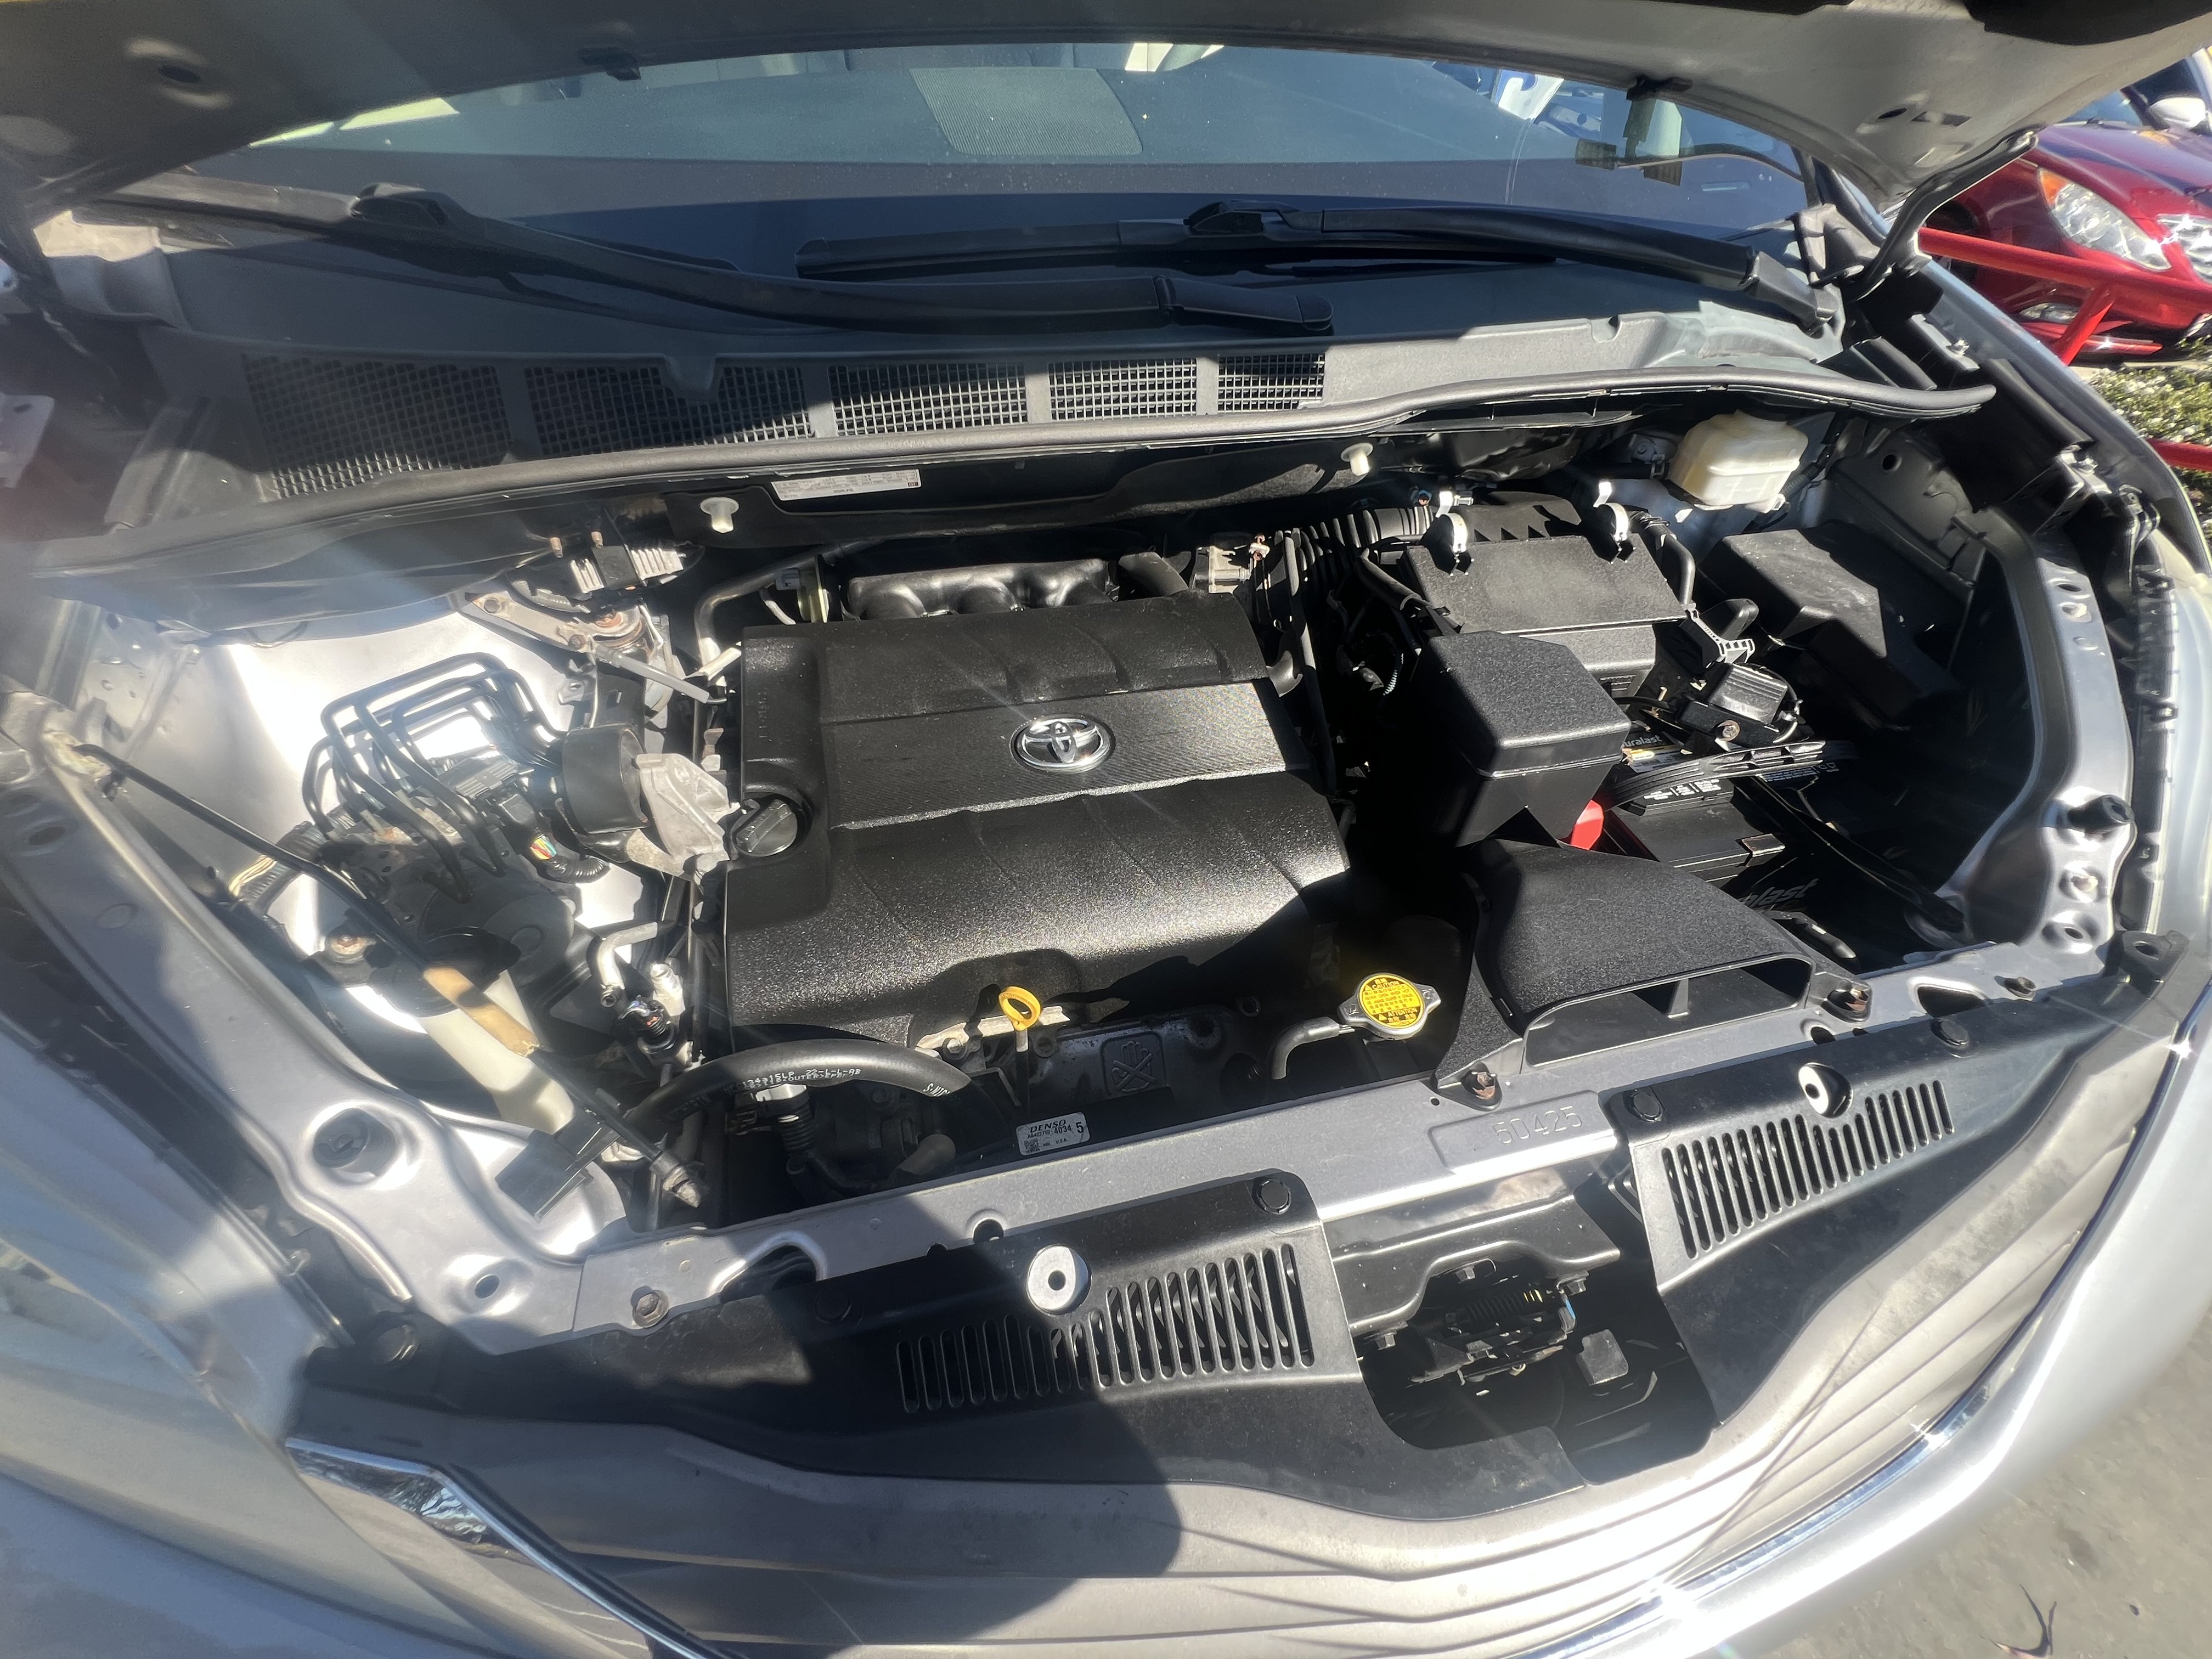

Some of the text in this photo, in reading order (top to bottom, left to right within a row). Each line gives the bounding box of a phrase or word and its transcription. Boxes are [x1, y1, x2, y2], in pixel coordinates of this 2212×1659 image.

[1622, 735, 1663, 747] uralast
[1737, 877, 1821, 907] alast
[1372, 980, 1400, 990] CAUTION
[1387, 1007, 1418, 1018] ATTENTION
[1030, 1119, 1066, 1133] DENSO
[1075, 1121, 1084, 1133] 5
[1492, 1105, 1583, 1144] 50425
